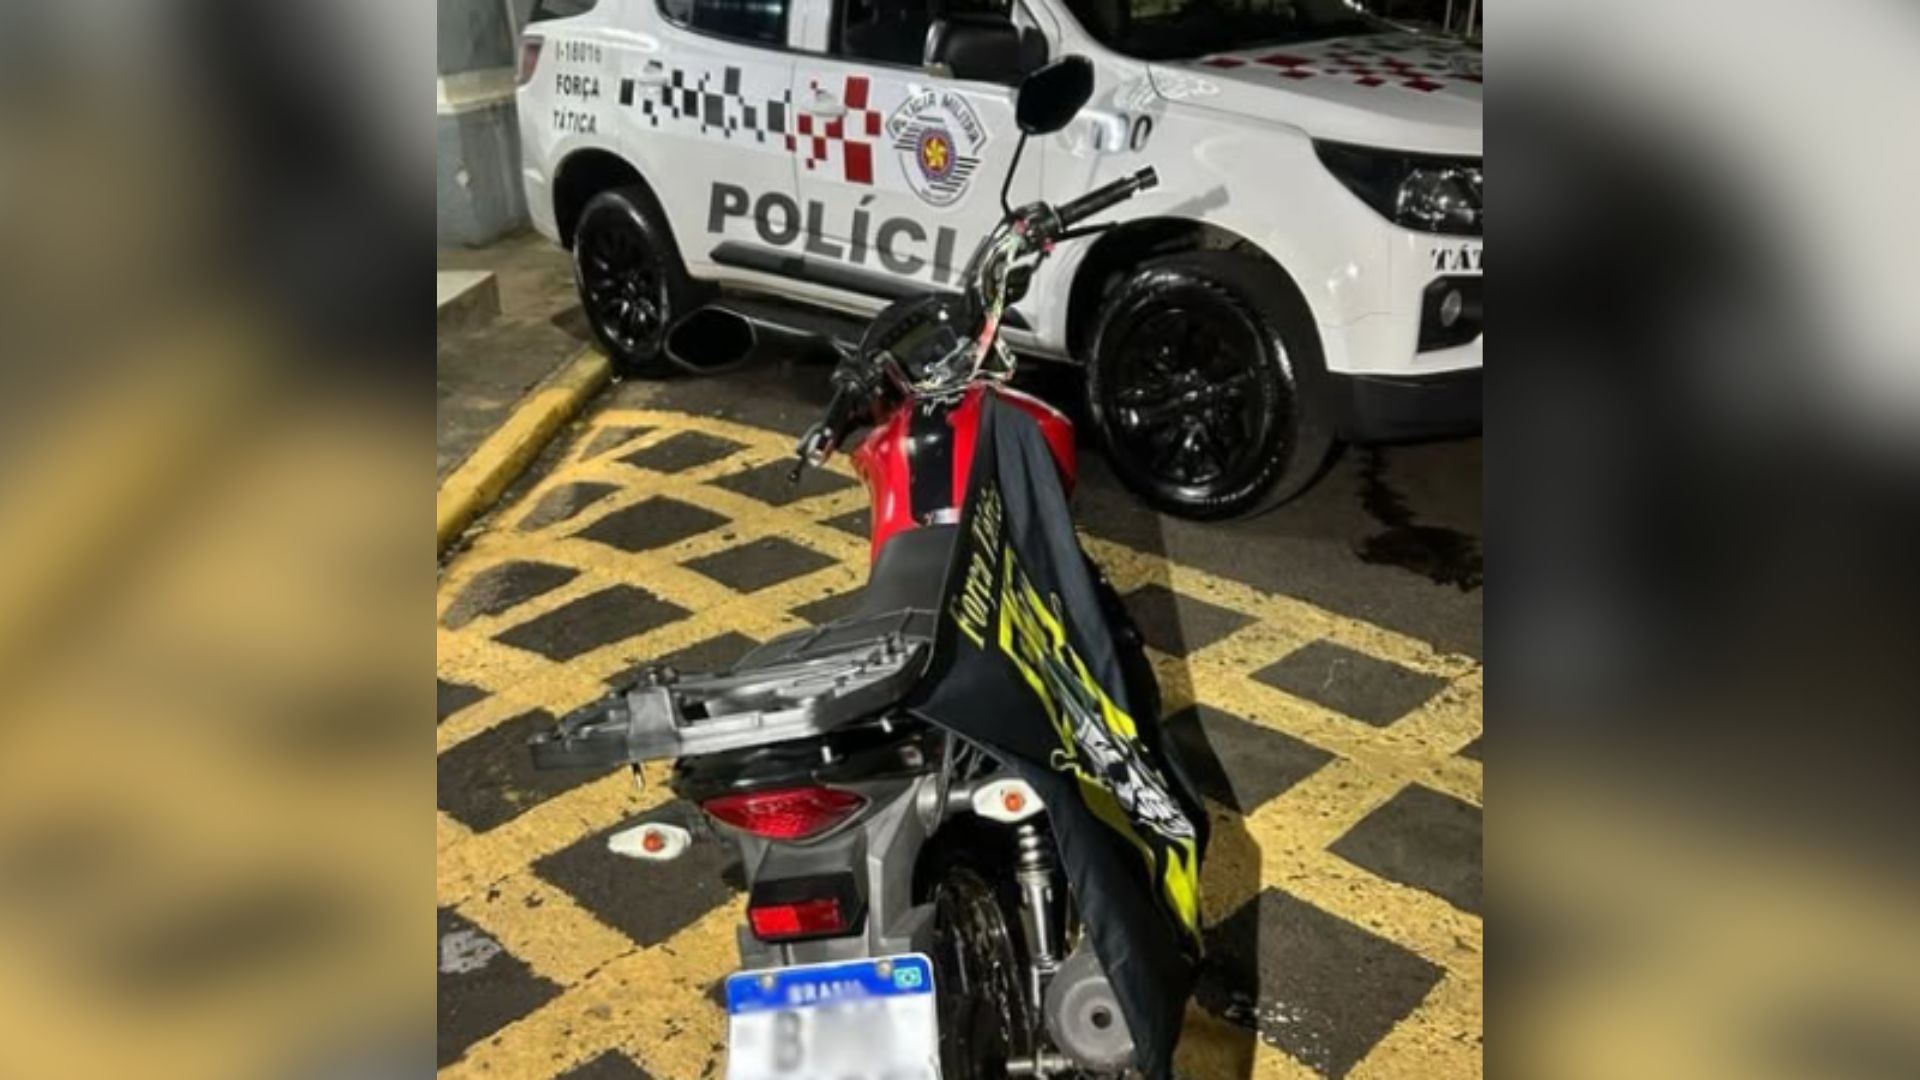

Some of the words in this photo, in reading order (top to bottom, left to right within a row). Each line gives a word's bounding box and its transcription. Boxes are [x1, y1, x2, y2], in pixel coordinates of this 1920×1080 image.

[556, 73, 600, 102] FORÇA
[553, 106, 597, 134] TÁTICA
[707, 181, 982, 286] POLÍCI
